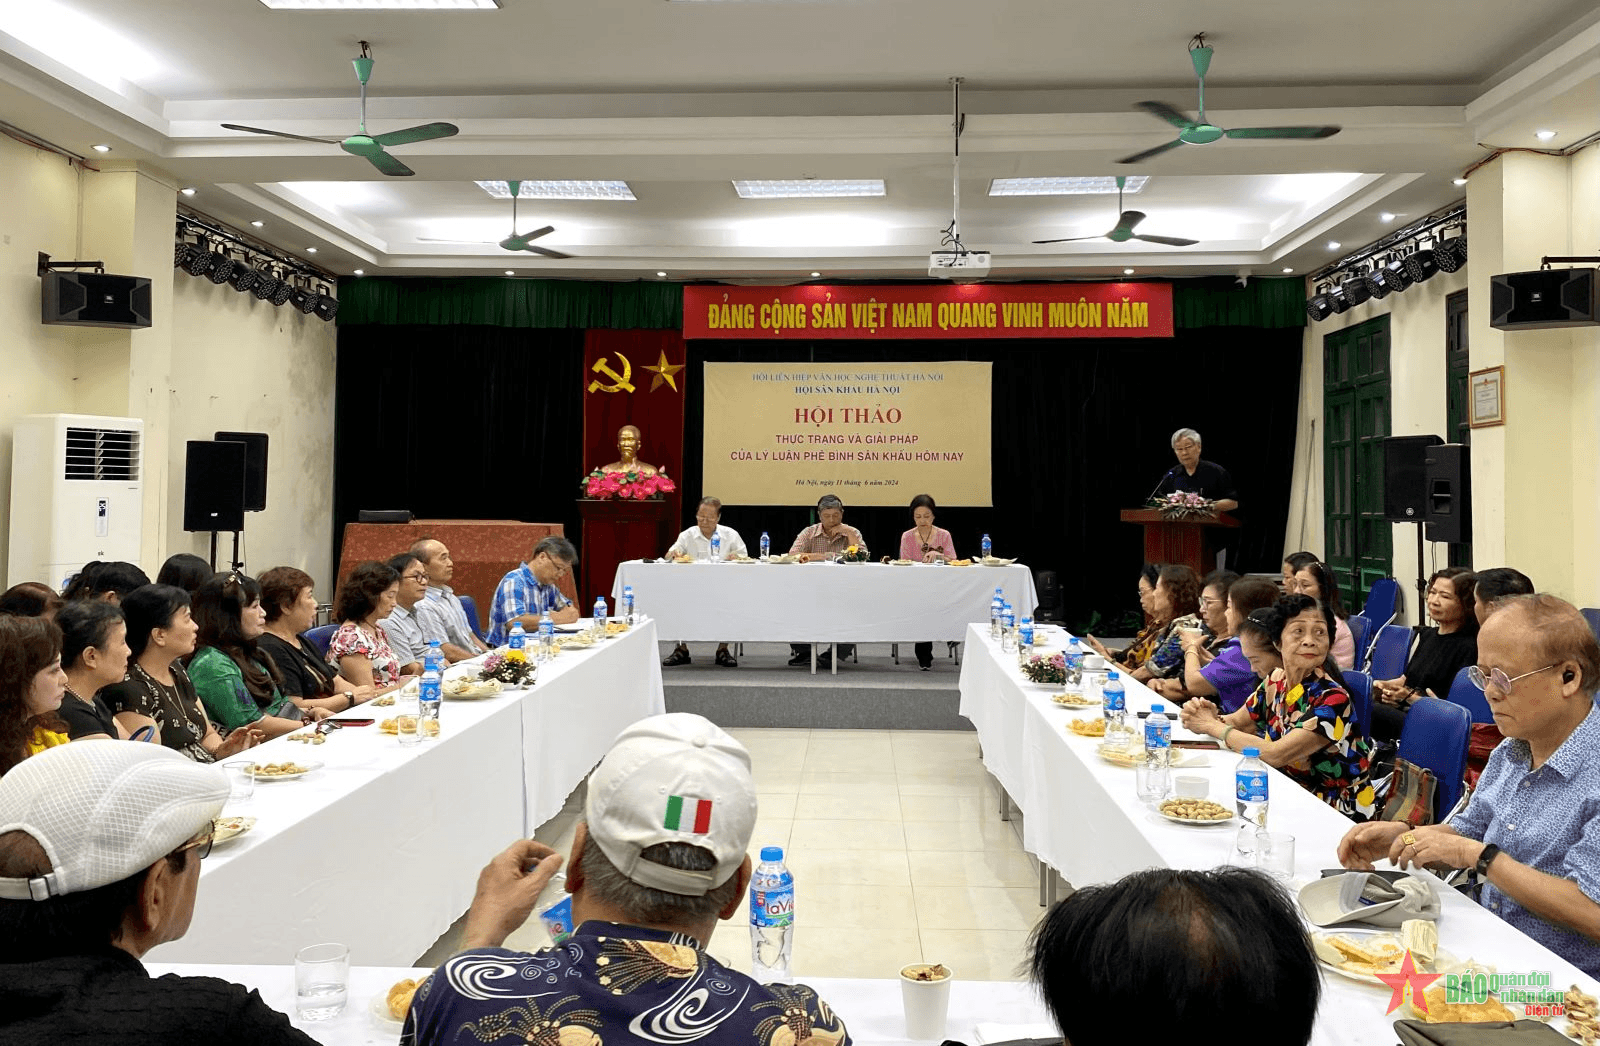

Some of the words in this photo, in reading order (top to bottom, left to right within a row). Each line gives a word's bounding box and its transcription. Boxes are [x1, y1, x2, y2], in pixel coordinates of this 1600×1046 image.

[708, 292, 755, 329] ĐẢNG
[760, 298, 807, 334] CỘNG
[811, 292, 847, 329] SẢN
[851, 298, 887, 334] VIỆT
[892, 302, 933, 328] NAM
[937, 302, 997, 330] QUANG
[1002, 302, 1044, 328] VINH
[1048, 297, 1102, 328] MUÔN
[1107, 297, 1149, 328] NĂM
[794, 405, 834, 428] HỘI
[840, 403, 902, 424] THẢO
[775, 434, 805, 446] THỰC
[808, 434, 845, 446] TRẠNG
[848, 432, 863, 444] VÀ
[865, 431, 887, 444] GIẢI
[889, 432, 919, 444] PHÁP
[730, 447, 753, 461] CỦA
[755, 449, 769, 461] LÝ
[772, 449, 801, 463] LUẬN
[803, 449, 825, 461] PHÊ
[828, 449, 854, 461] BÌNH
[857, 449, 879, 461] SÂN
[882, 448, 912, 461] KHẤU
[915, 449, 940, 461] HÔM
[943, 452, 964, 461] NAY
